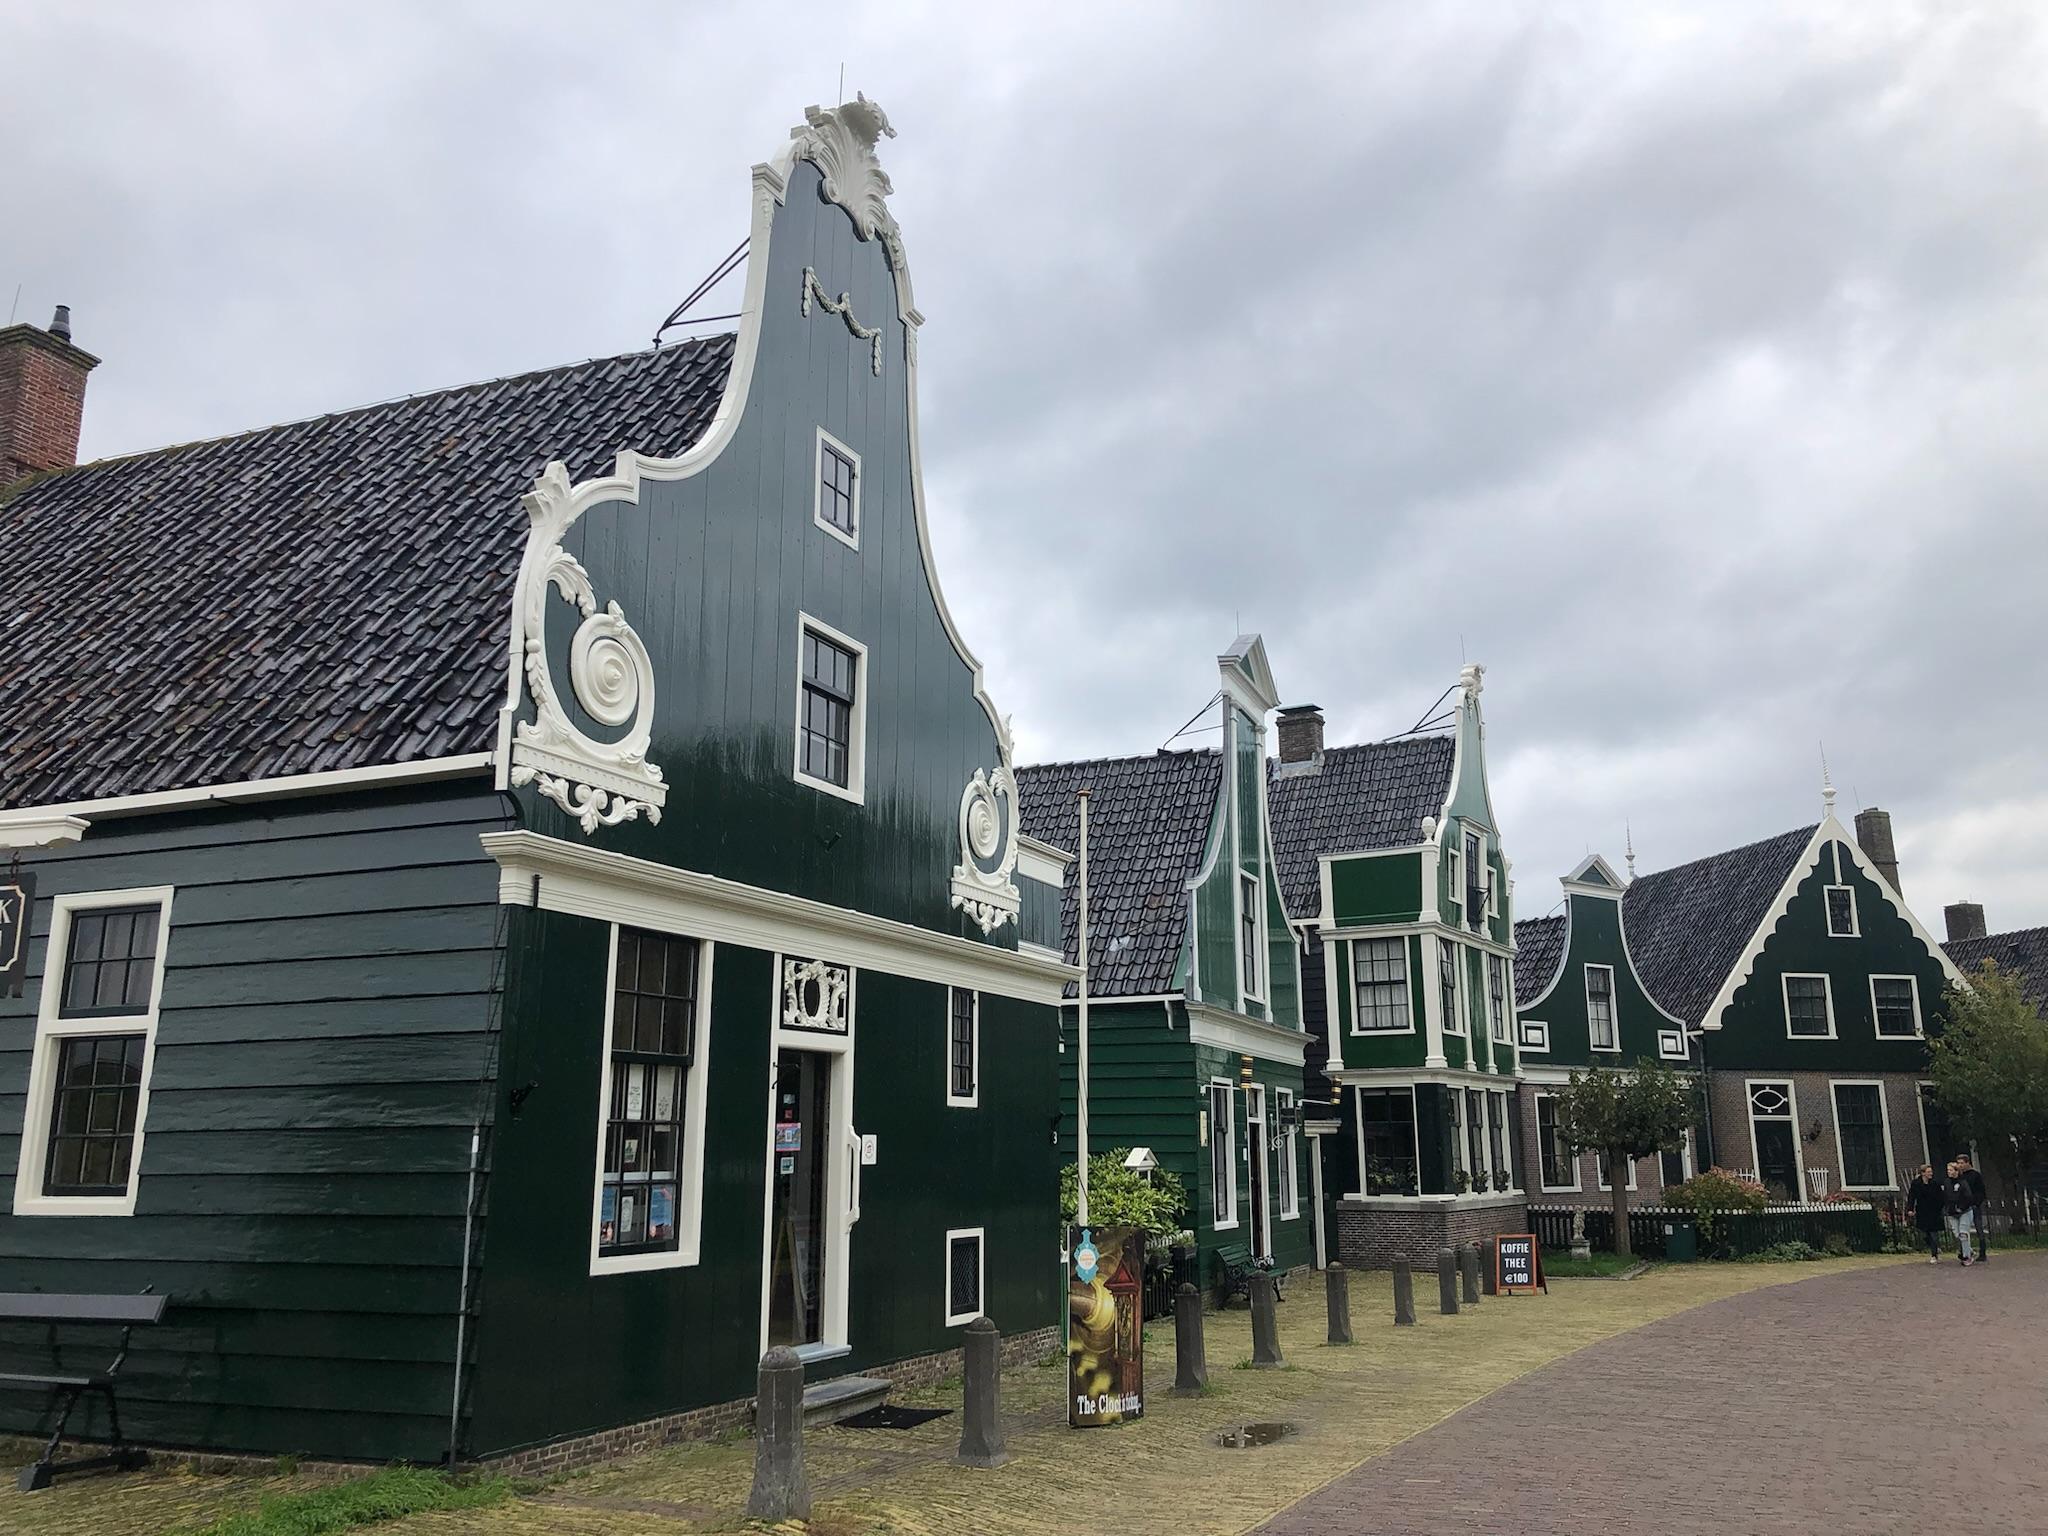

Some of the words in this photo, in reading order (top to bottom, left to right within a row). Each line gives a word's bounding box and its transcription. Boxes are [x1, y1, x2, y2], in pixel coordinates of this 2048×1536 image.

[1501, 1243, 1529, 1254] KOFFIE
[1505, 1258, 1526, 1268] THEE
[1505, 1273, 1528, 1283] €100
[1077, 1395, 1096, 1415] The
